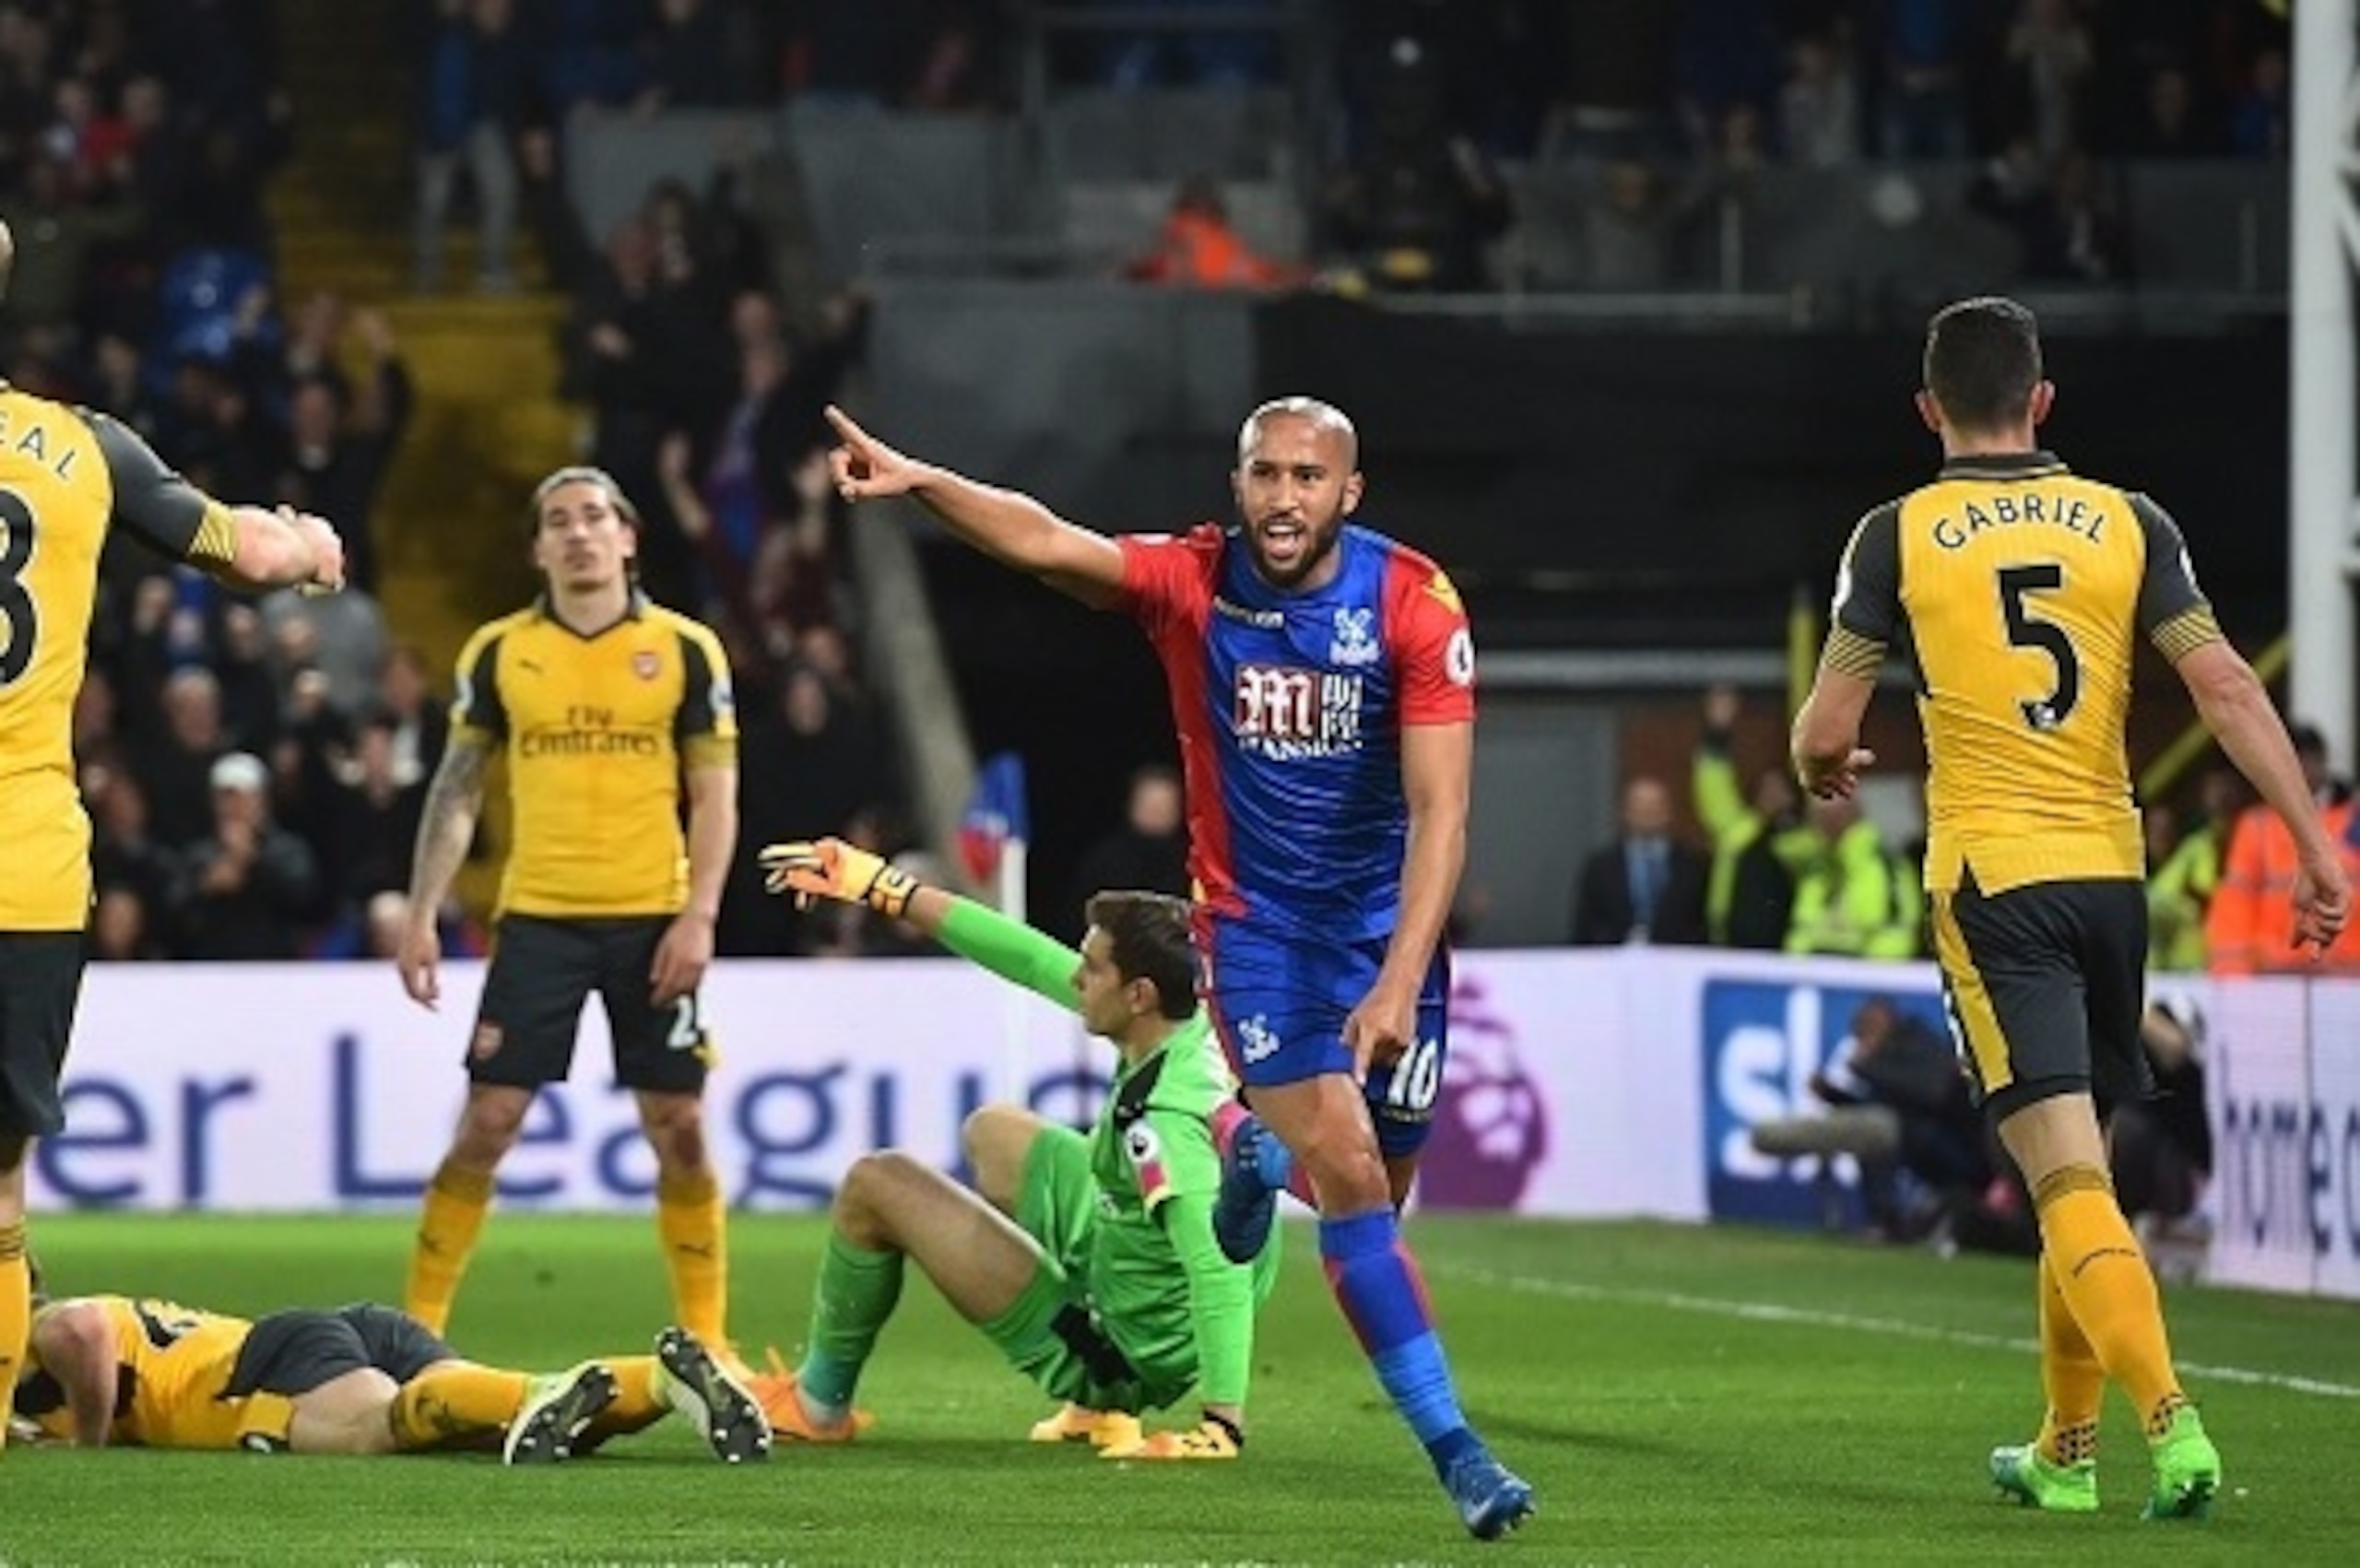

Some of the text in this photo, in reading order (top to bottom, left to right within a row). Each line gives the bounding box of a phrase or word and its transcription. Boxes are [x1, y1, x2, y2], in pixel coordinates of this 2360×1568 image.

[1934, 494, 2107, 550] GABRIEL
[1998, 564, 2078, 730] 5
[521, 729, 660, 758] Emirates
[1386, 1036, 1438, 1109] 10
